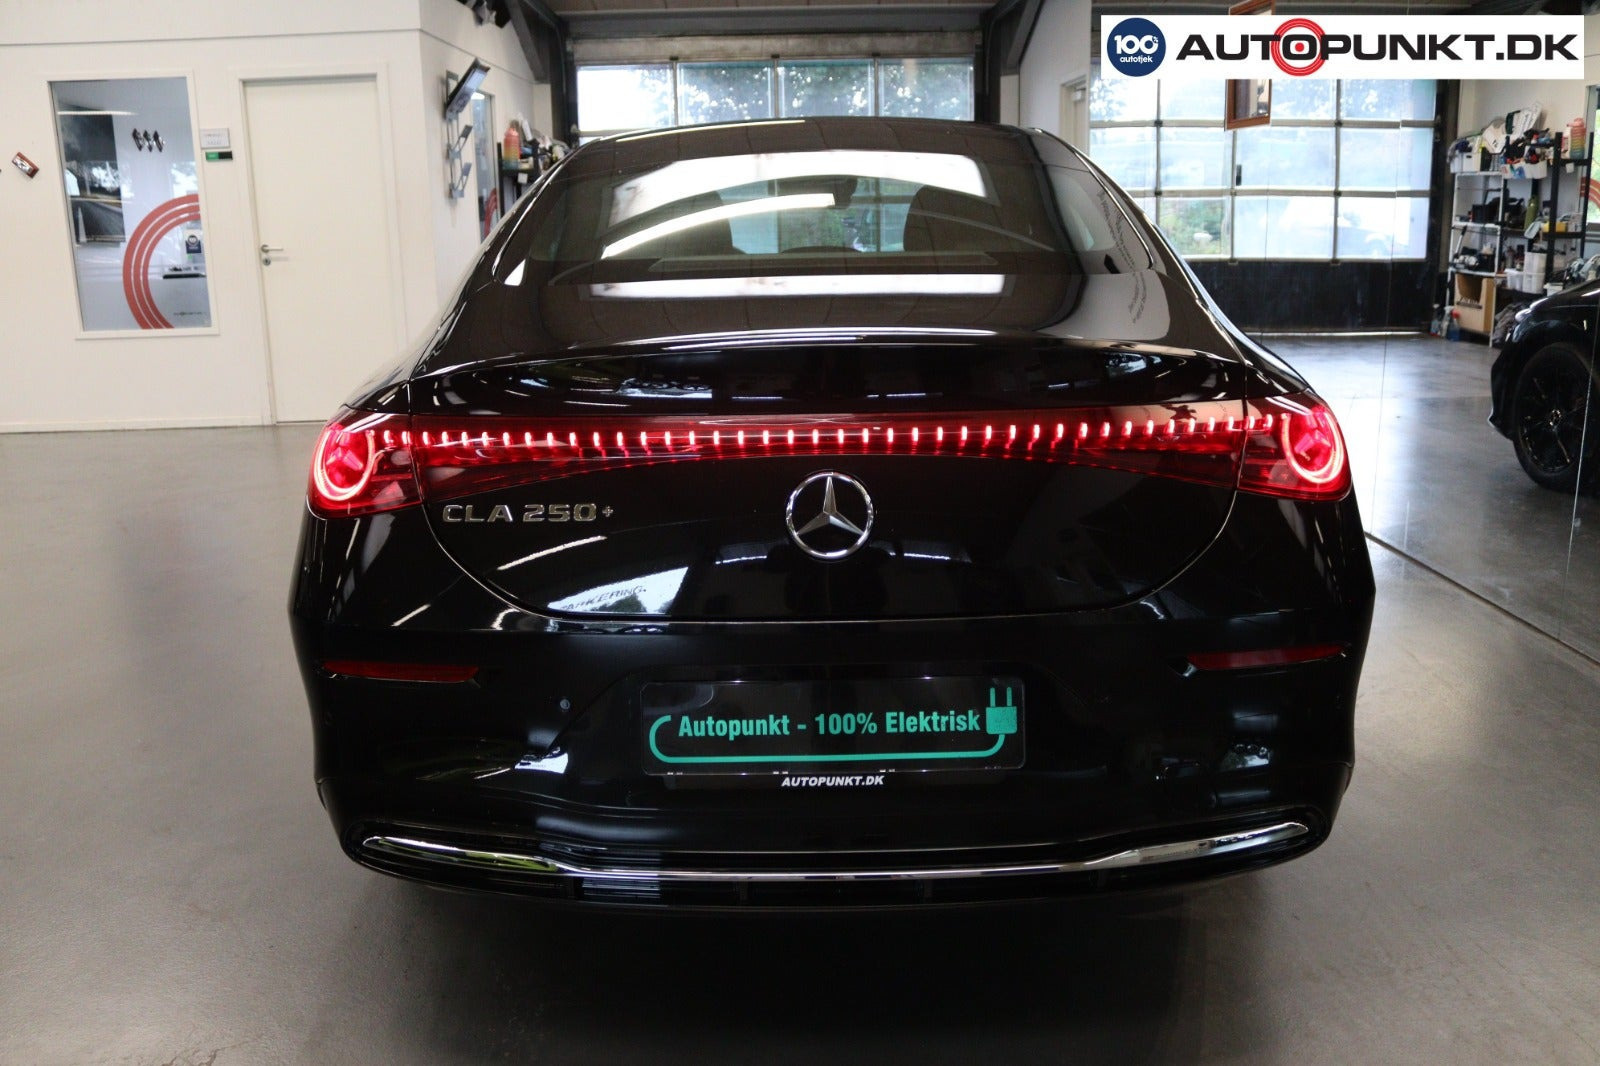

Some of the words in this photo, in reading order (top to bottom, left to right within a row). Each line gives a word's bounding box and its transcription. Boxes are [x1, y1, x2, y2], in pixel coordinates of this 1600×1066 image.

[442, 504, 514, 523] CLA
[678, 713, 790, 741] Autopunkt
[814, 712, 878, 735] 100%
[885, 709, 981, 733] Elektrisk
[781, 774, 885, 788] AUTOPUNKT.DK
